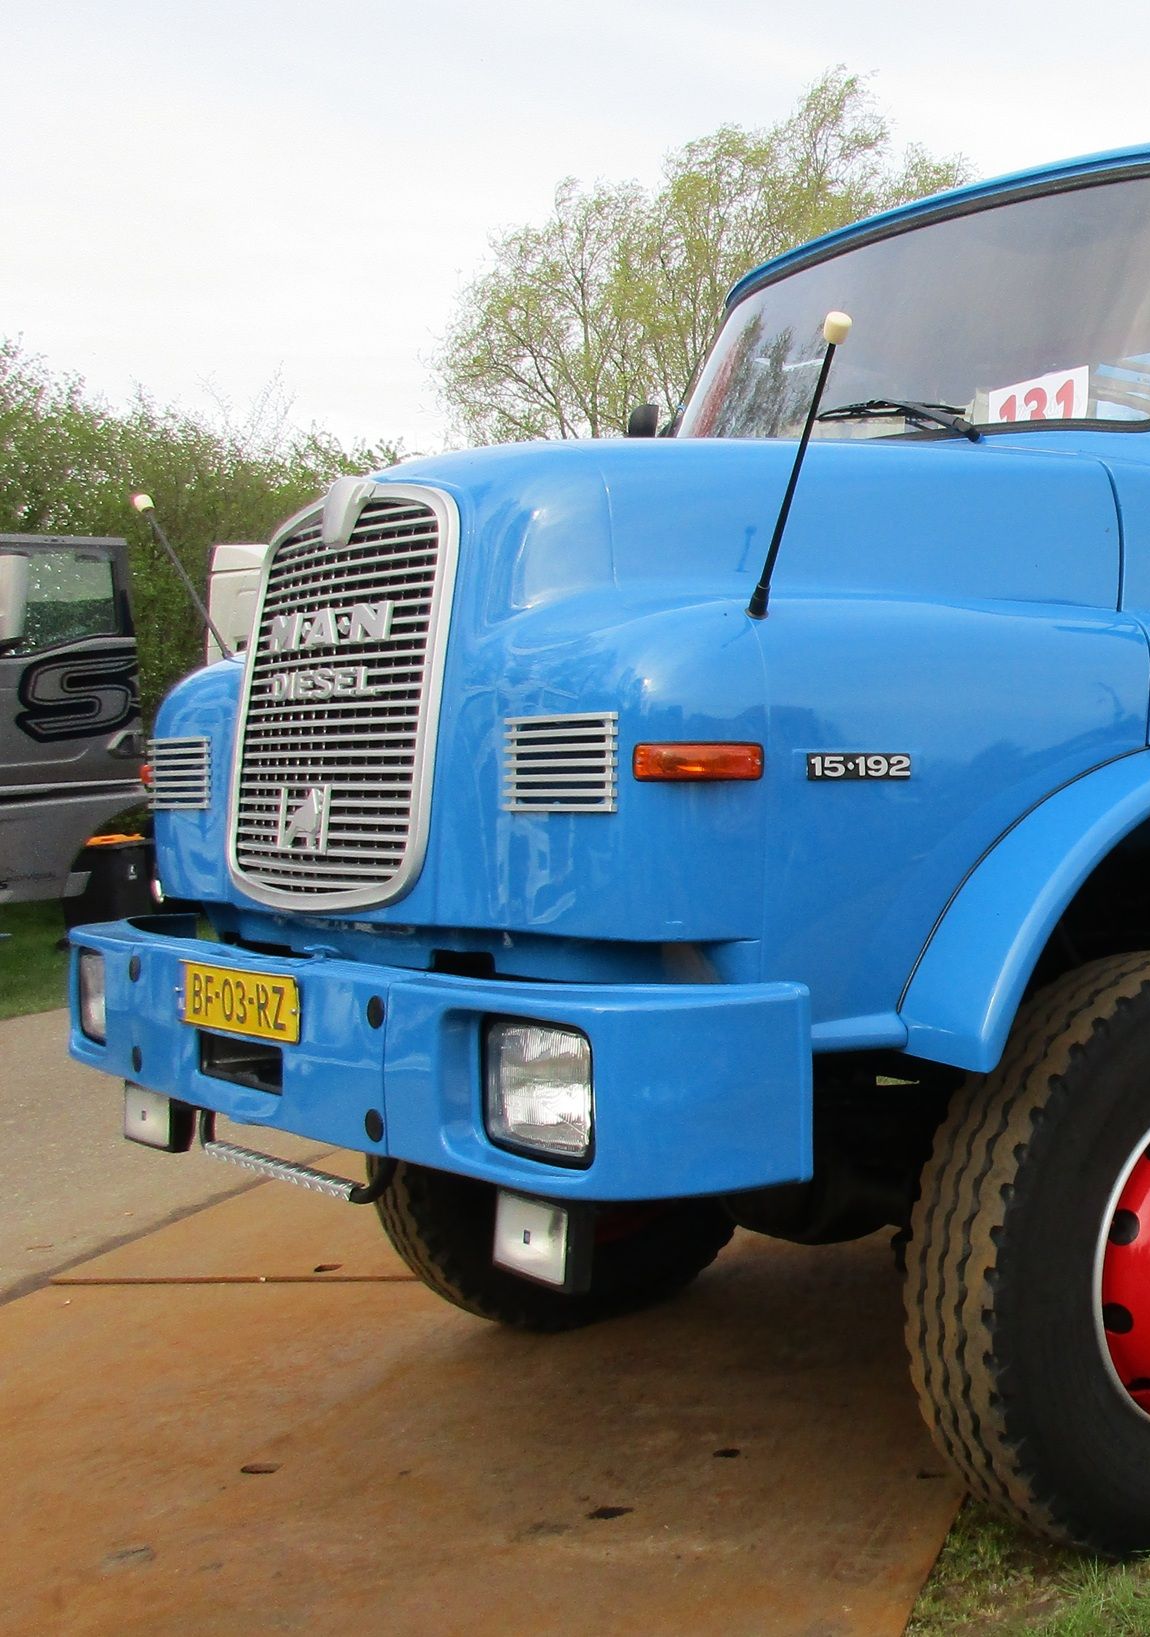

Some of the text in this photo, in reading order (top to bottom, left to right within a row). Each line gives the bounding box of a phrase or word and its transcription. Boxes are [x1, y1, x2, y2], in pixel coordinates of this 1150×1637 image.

[999, 379, 1074, 422] 131
[271, 666, 377, 702] DIESEL
[193, 973, 286, 1031] BF-03-RZ
